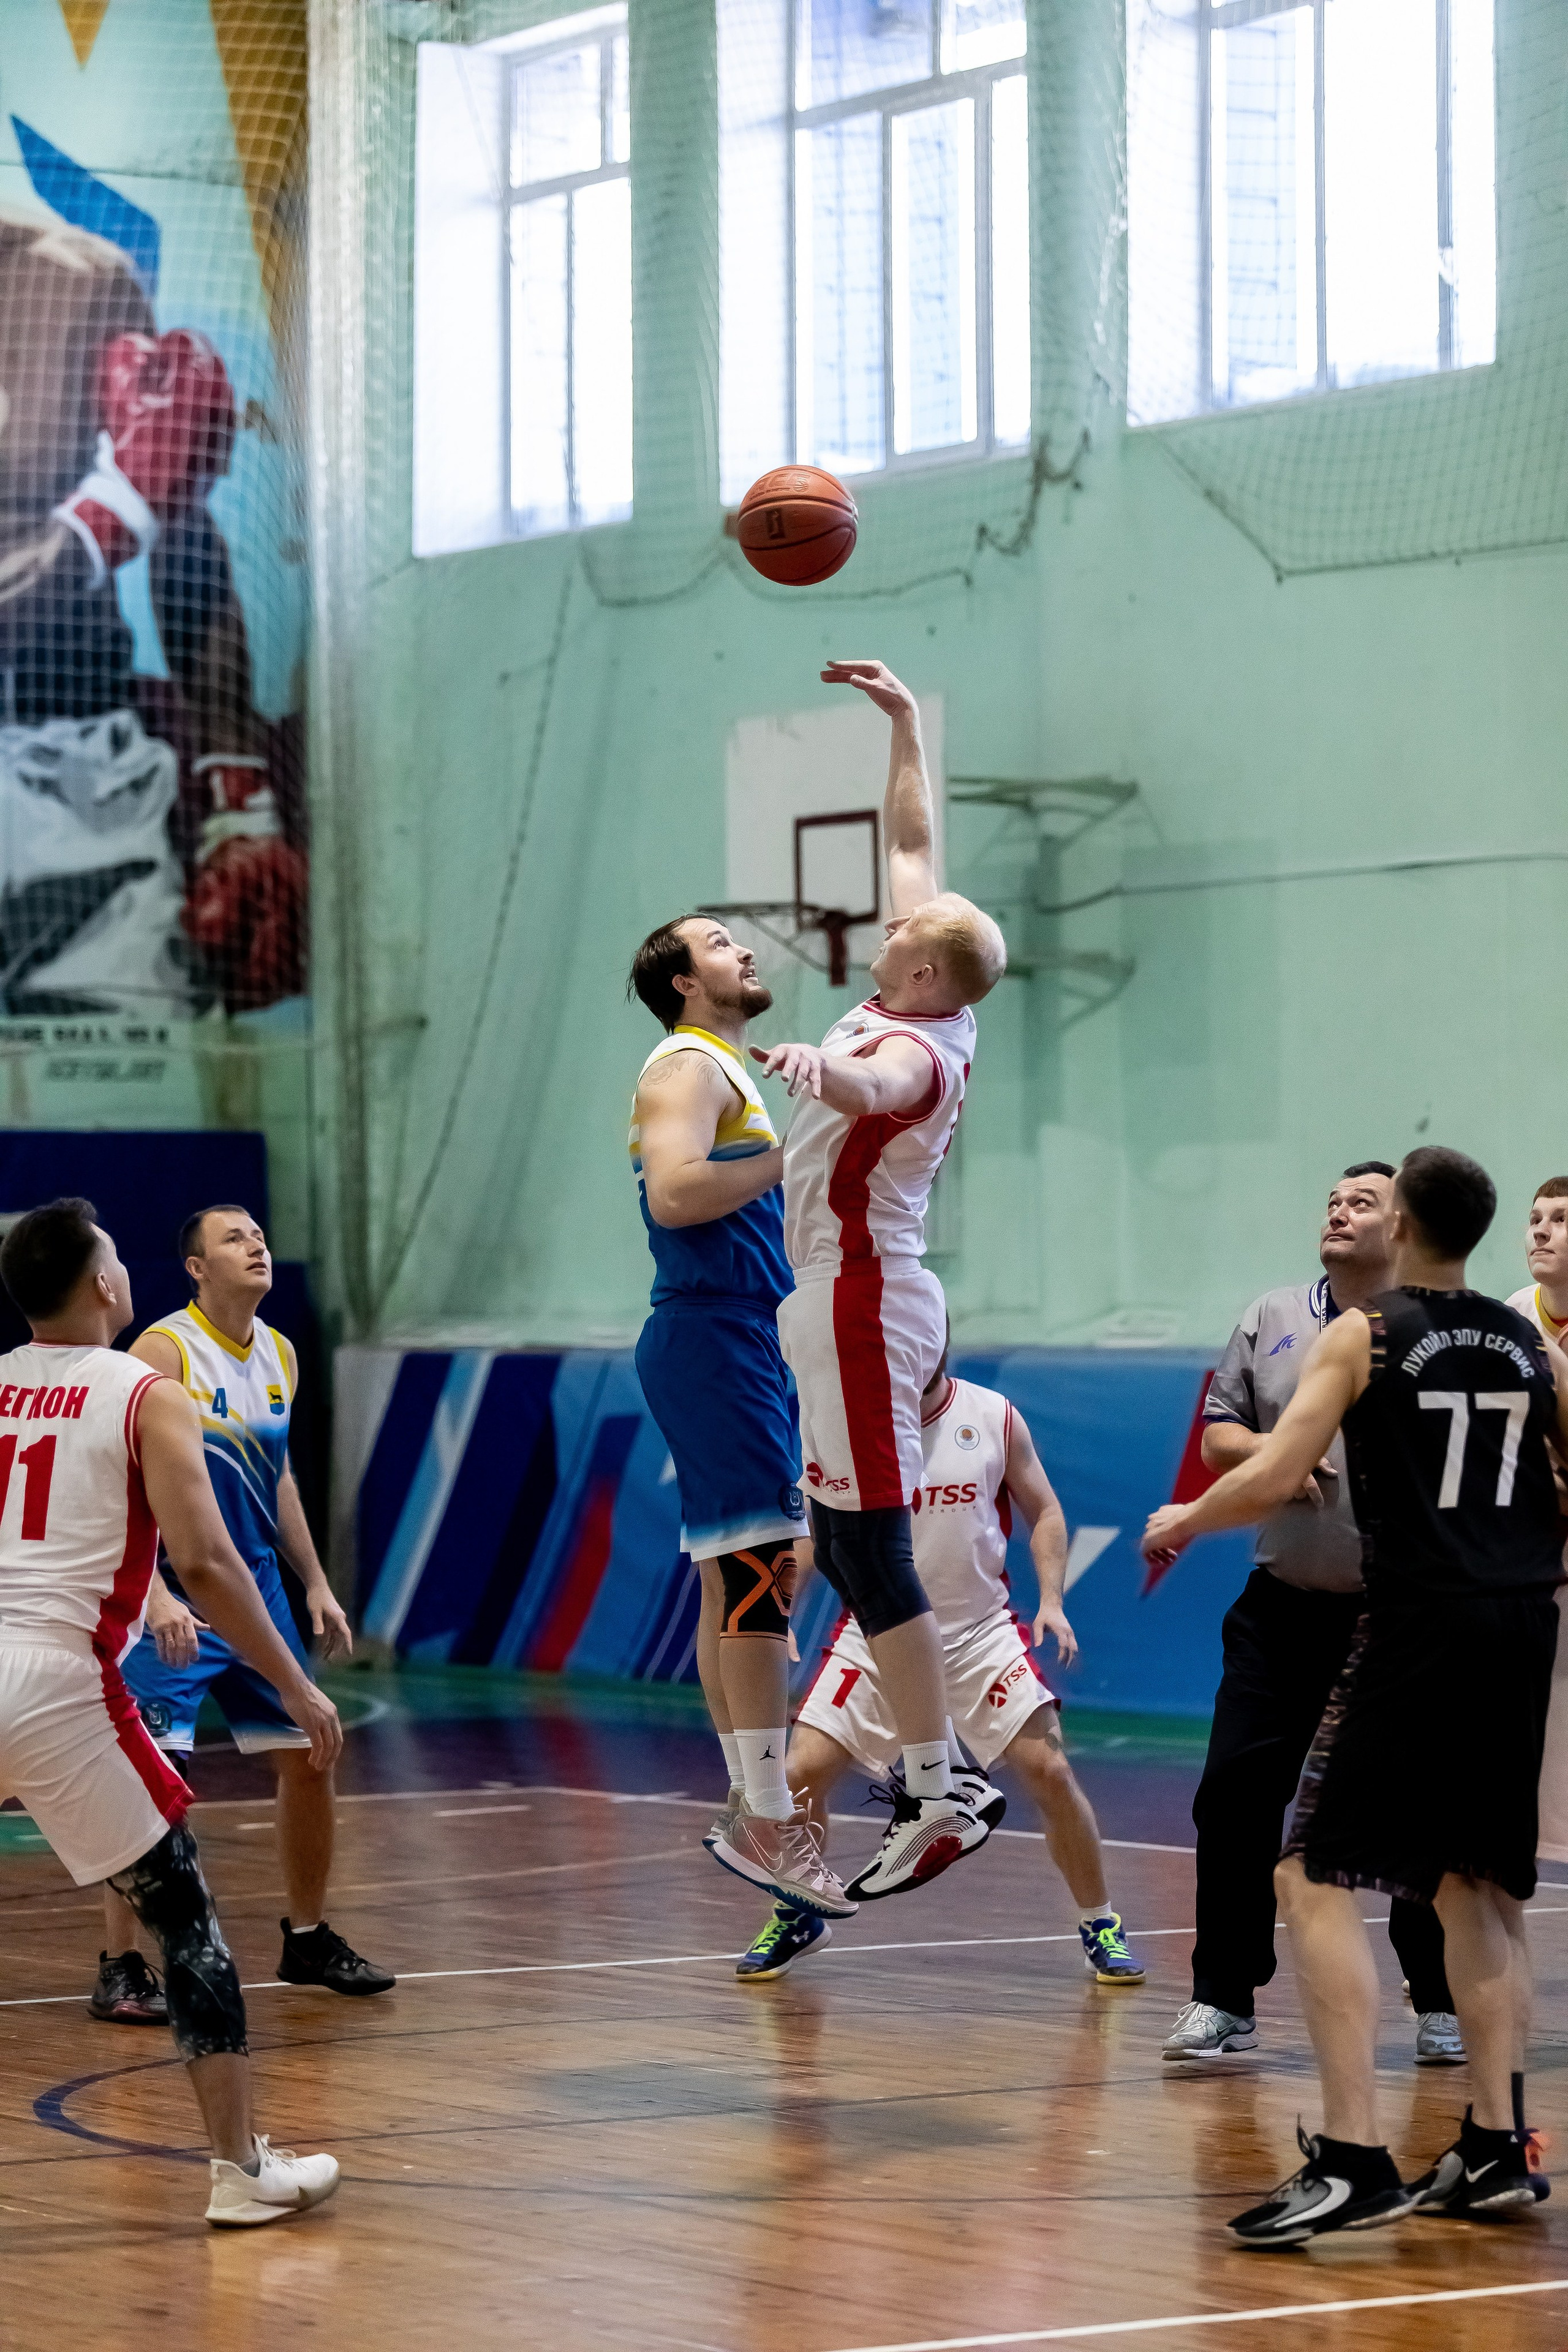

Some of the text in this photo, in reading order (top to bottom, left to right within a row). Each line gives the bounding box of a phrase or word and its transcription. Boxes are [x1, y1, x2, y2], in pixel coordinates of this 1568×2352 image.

[1401, 1330, 1452, 1377] ЛУКОЙЛ
[1485, 1333, 1535, 1378] СЕРВИС
[0, 1384, 90, 1420] ЕГИОН
[212, 1388, 228, 1419] 4
[1417, 1391, 1531, 1509] 77
[925, 1483, 977, 1507] TSS
[831, 1668, 862, 1709] 1
[1003, 1664, 1027, 1687] TSS
